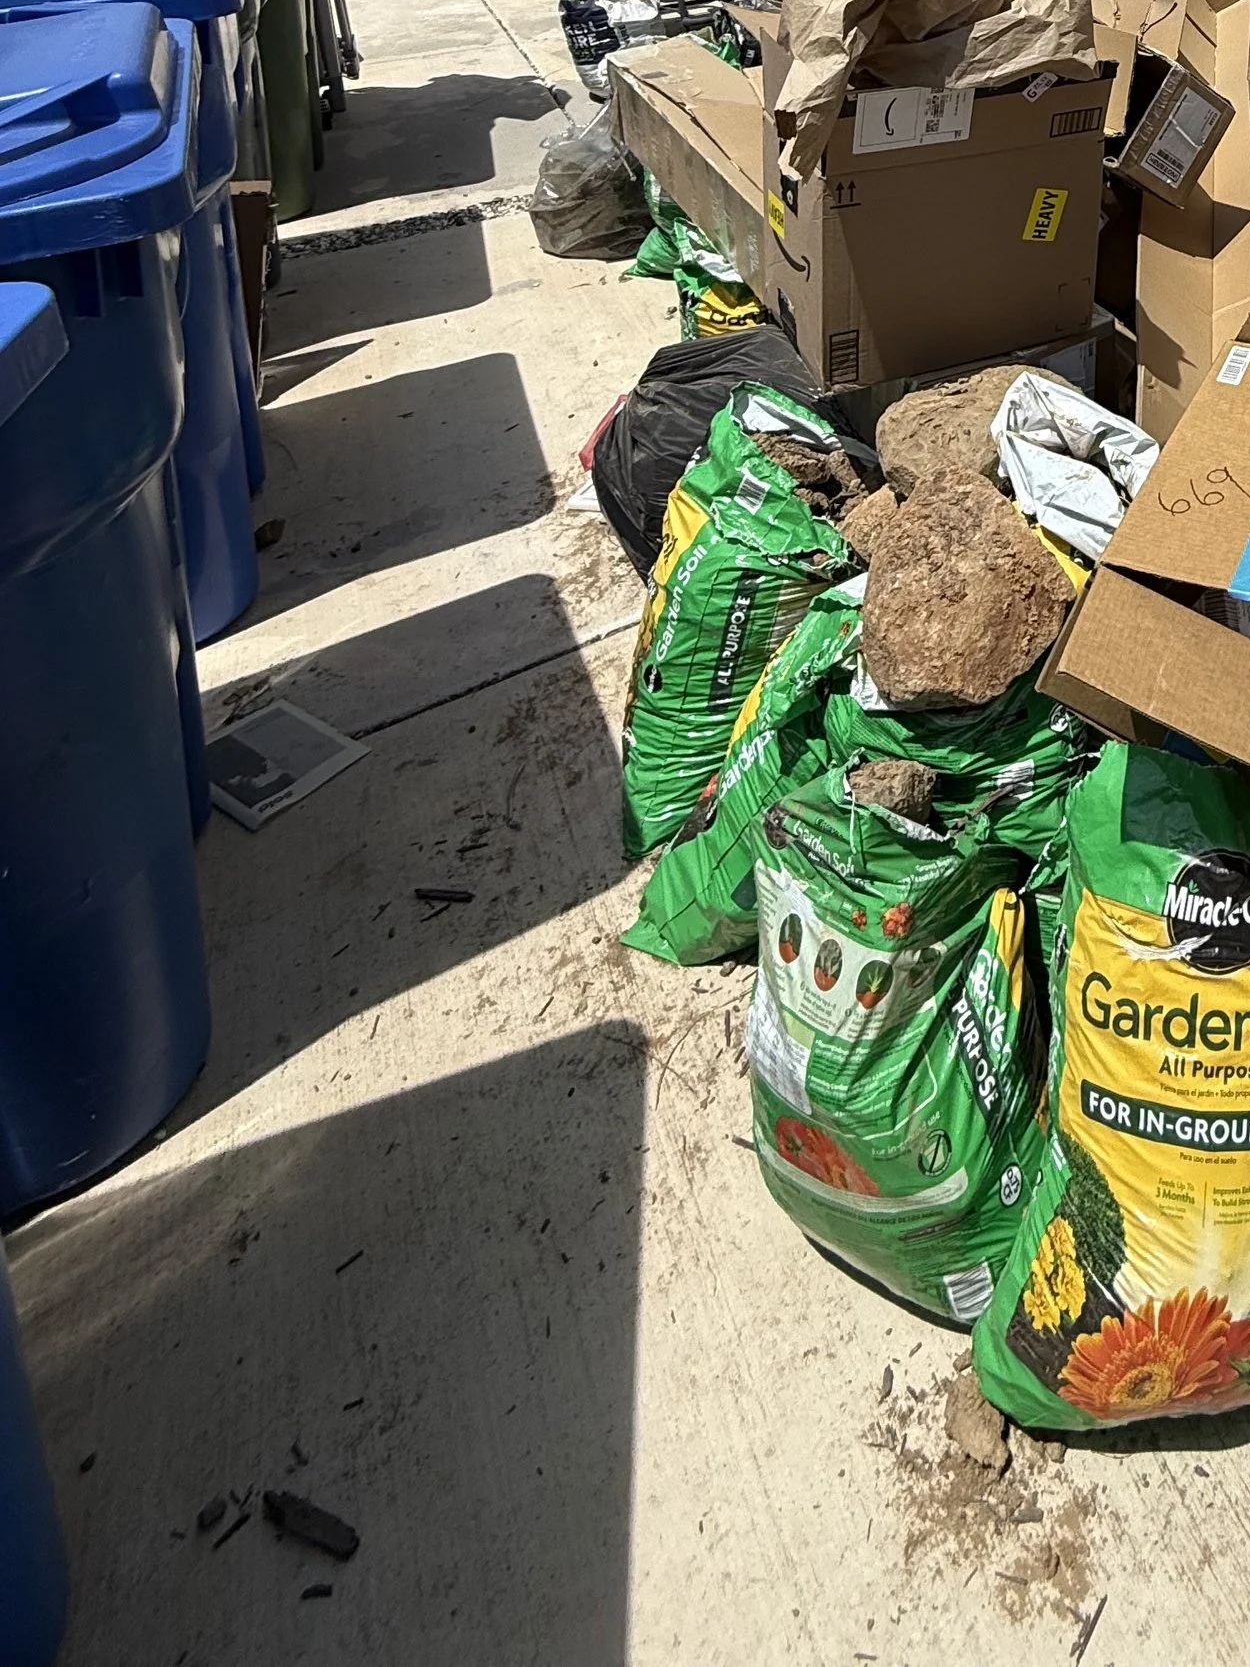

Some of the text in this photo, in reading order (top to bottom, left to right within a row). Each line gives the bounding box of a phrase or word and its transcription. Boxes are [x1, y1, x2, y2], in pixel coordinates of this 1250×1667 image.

[1032, 191, 1058, 239] HEAVY
[1158, 466, 1250, 516] 669
[656, 544, 708, 661] Garden Soil
[722, 595, 751, 661] PURPOSE
[793, 820, 832, 866] Garden
[951, 987, 999, 1111] PURPOSE
[1159, 1056, 1186, 1076] All
[1089, 1091, 1131, 1127] FOR
[1162, 1189, 1196, 1205] Months
